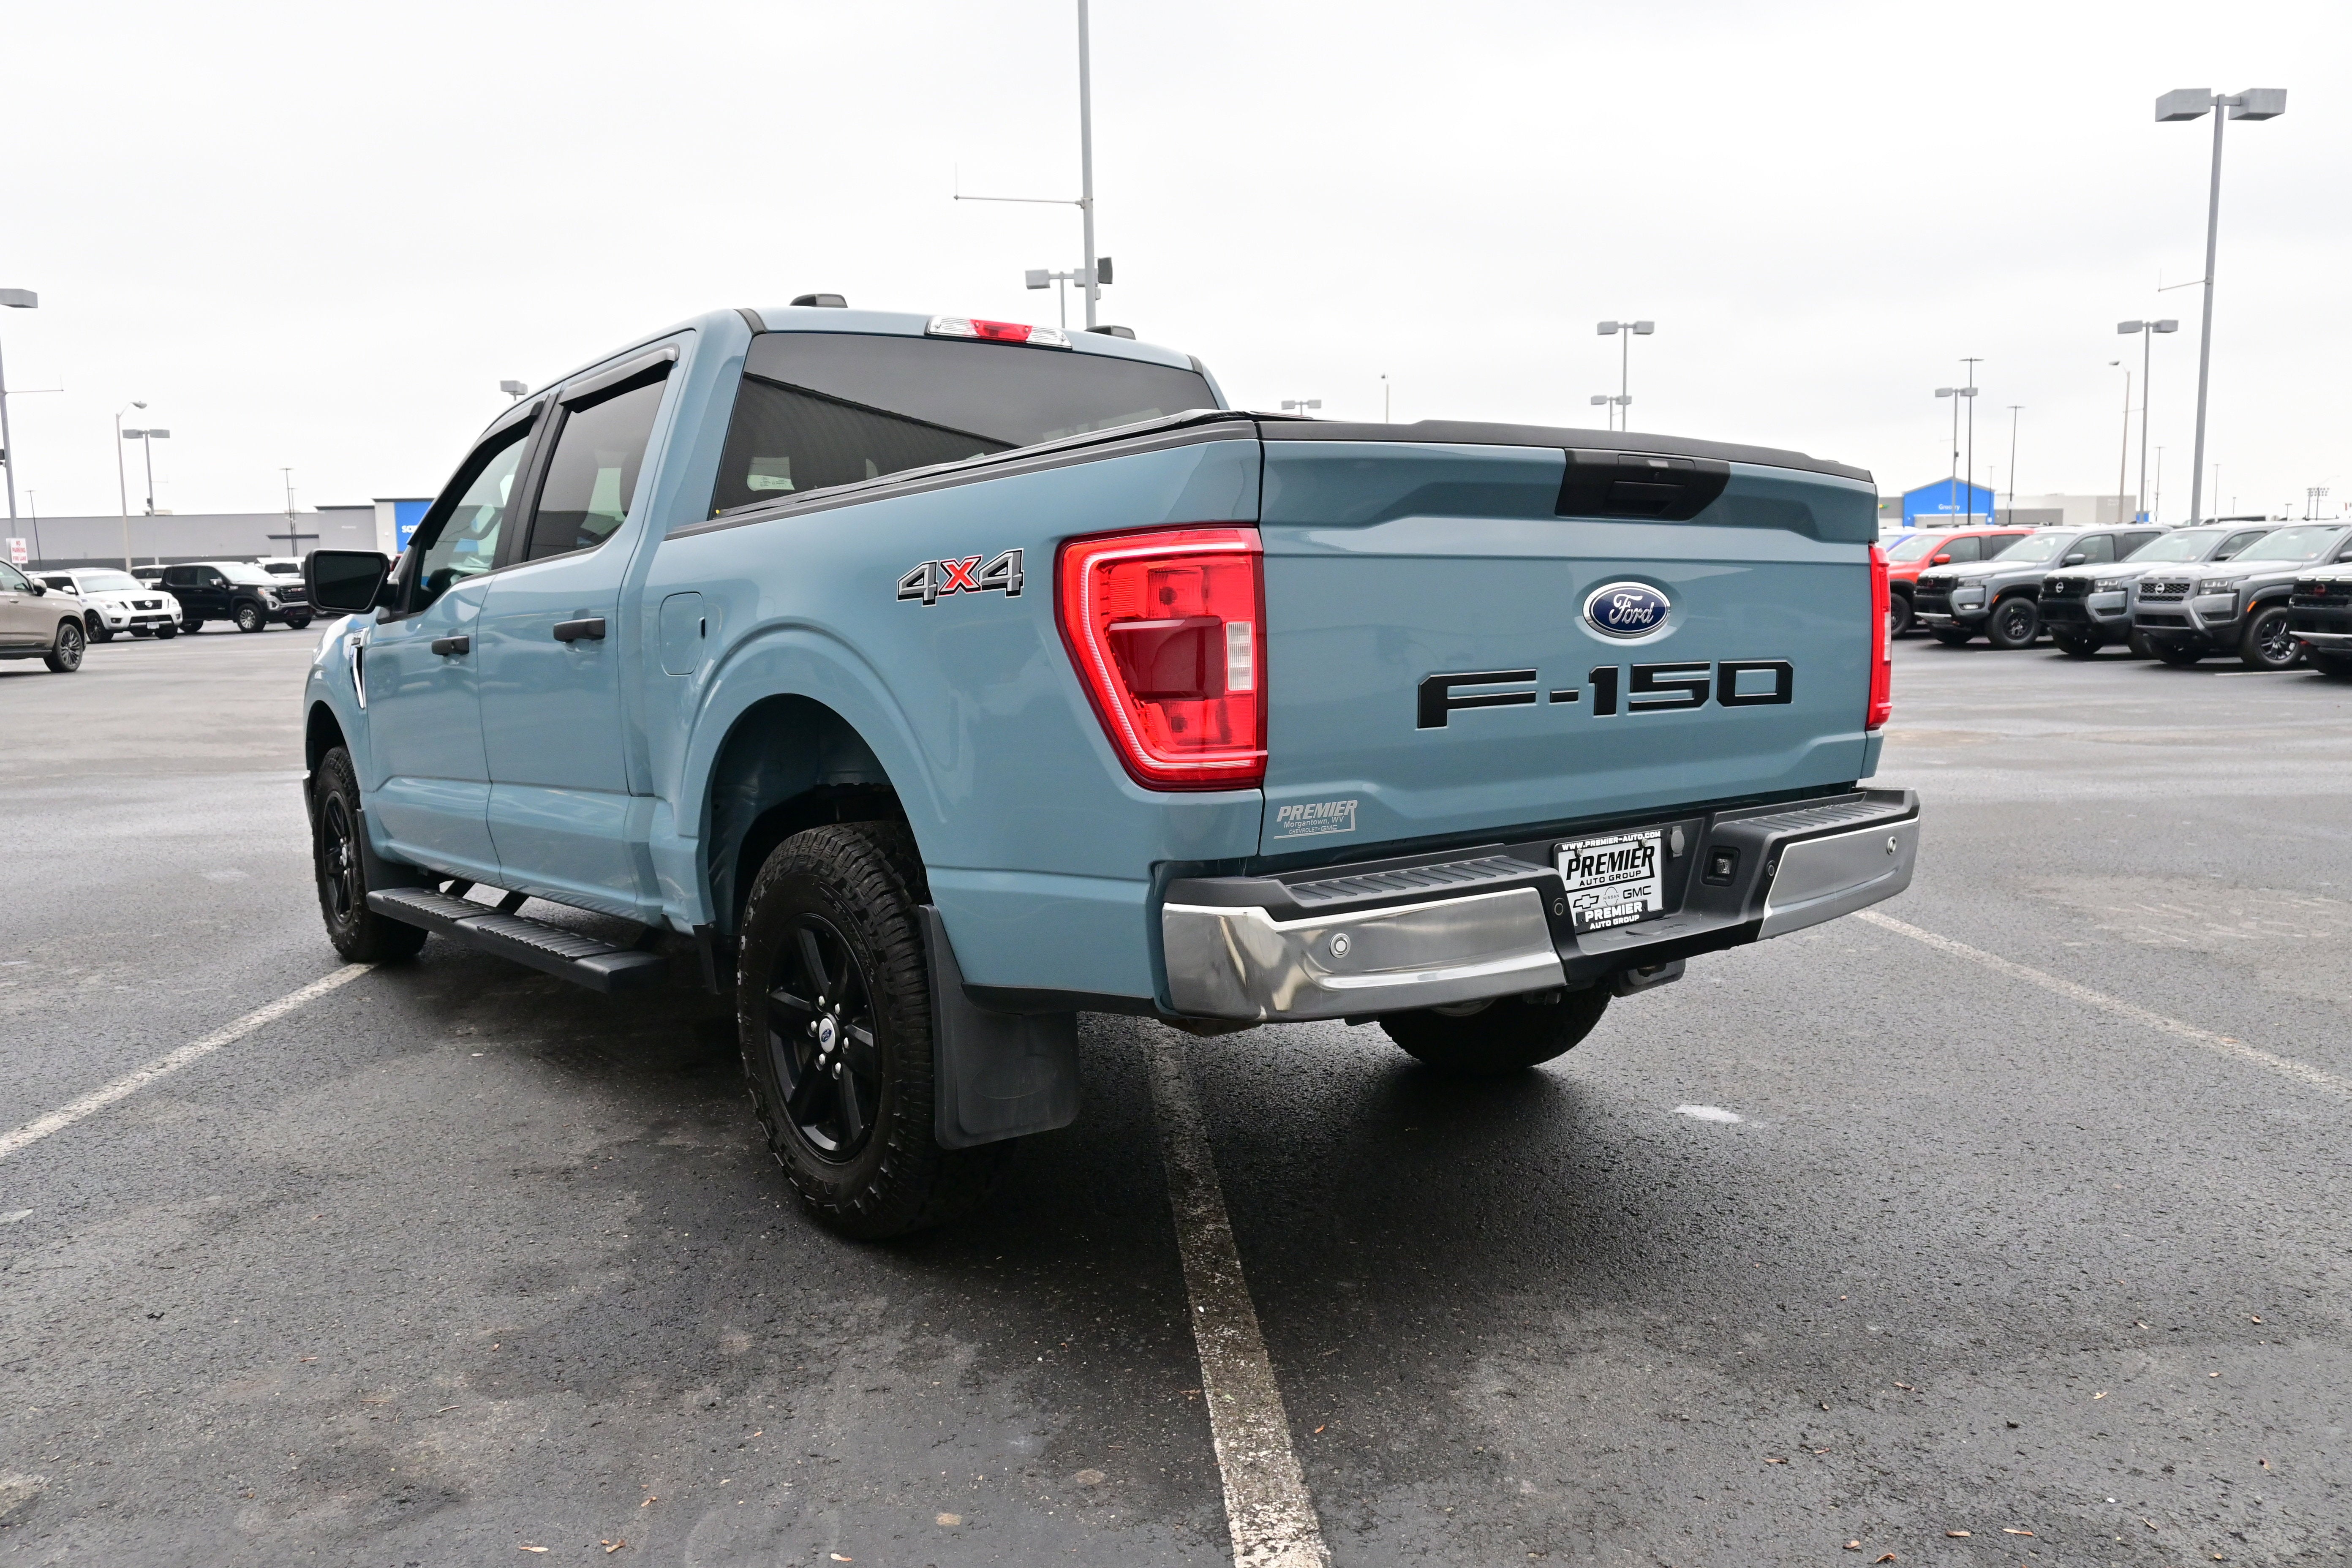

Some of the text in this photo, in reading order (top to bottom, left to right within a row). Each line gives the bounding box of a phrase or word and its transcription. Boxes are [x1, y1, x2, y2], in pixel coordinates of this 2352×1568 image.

[1609, 593, 1655, 624] Ford
[1417, 660, 1794, 729] F-150
[1277, 800, 1358, 822] PREMIER
[1284, 819, 1329, 828] Morgantown,
[1289, 827, 1318, 835] CHEVROLET
[1562, 831, 1661, 851] WWW.PREMIER-AUTO.COM
[1566, 845, 1655, 881] PREMIER
[1579, 870, 1641, 887] AUTO GROUP
[1623, 885, 1652, 899] GMC
[1585, 901, 1642, 922] PREMIER
[1590, 914, 1640, 930] AUTO GROUP
